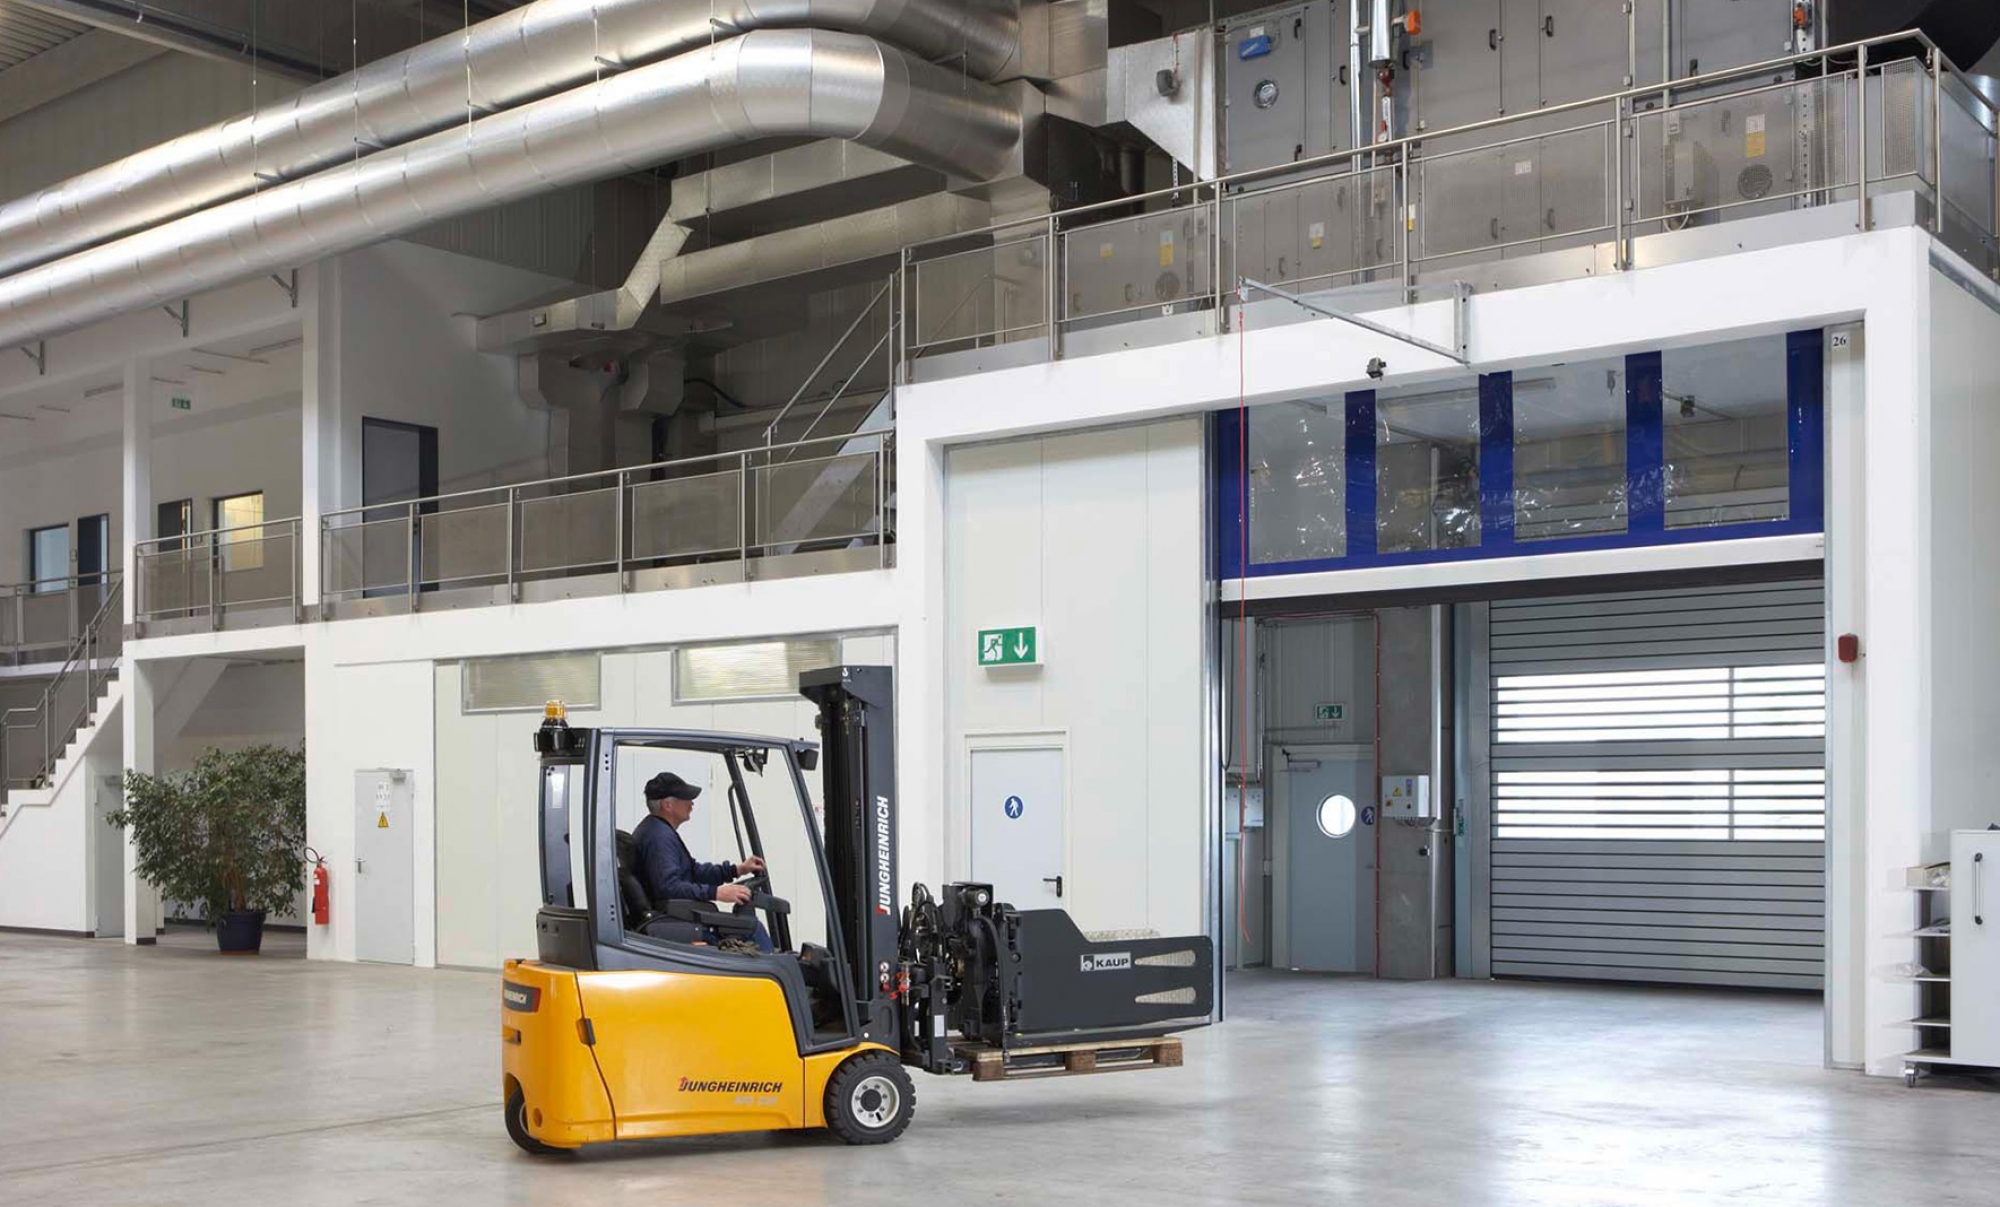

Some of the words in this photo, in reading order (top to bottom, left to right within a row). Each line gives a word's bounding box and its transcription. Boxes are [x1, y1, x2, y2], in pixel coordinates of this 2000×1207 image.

[1833, 336, 1847, 346] 26
[876, 795, 891, 915] JUNGHEINRICH
[1095, 958, 1129, 968] KAUP
[678, 1078, 783, 1093] JUNGHEINRICH
